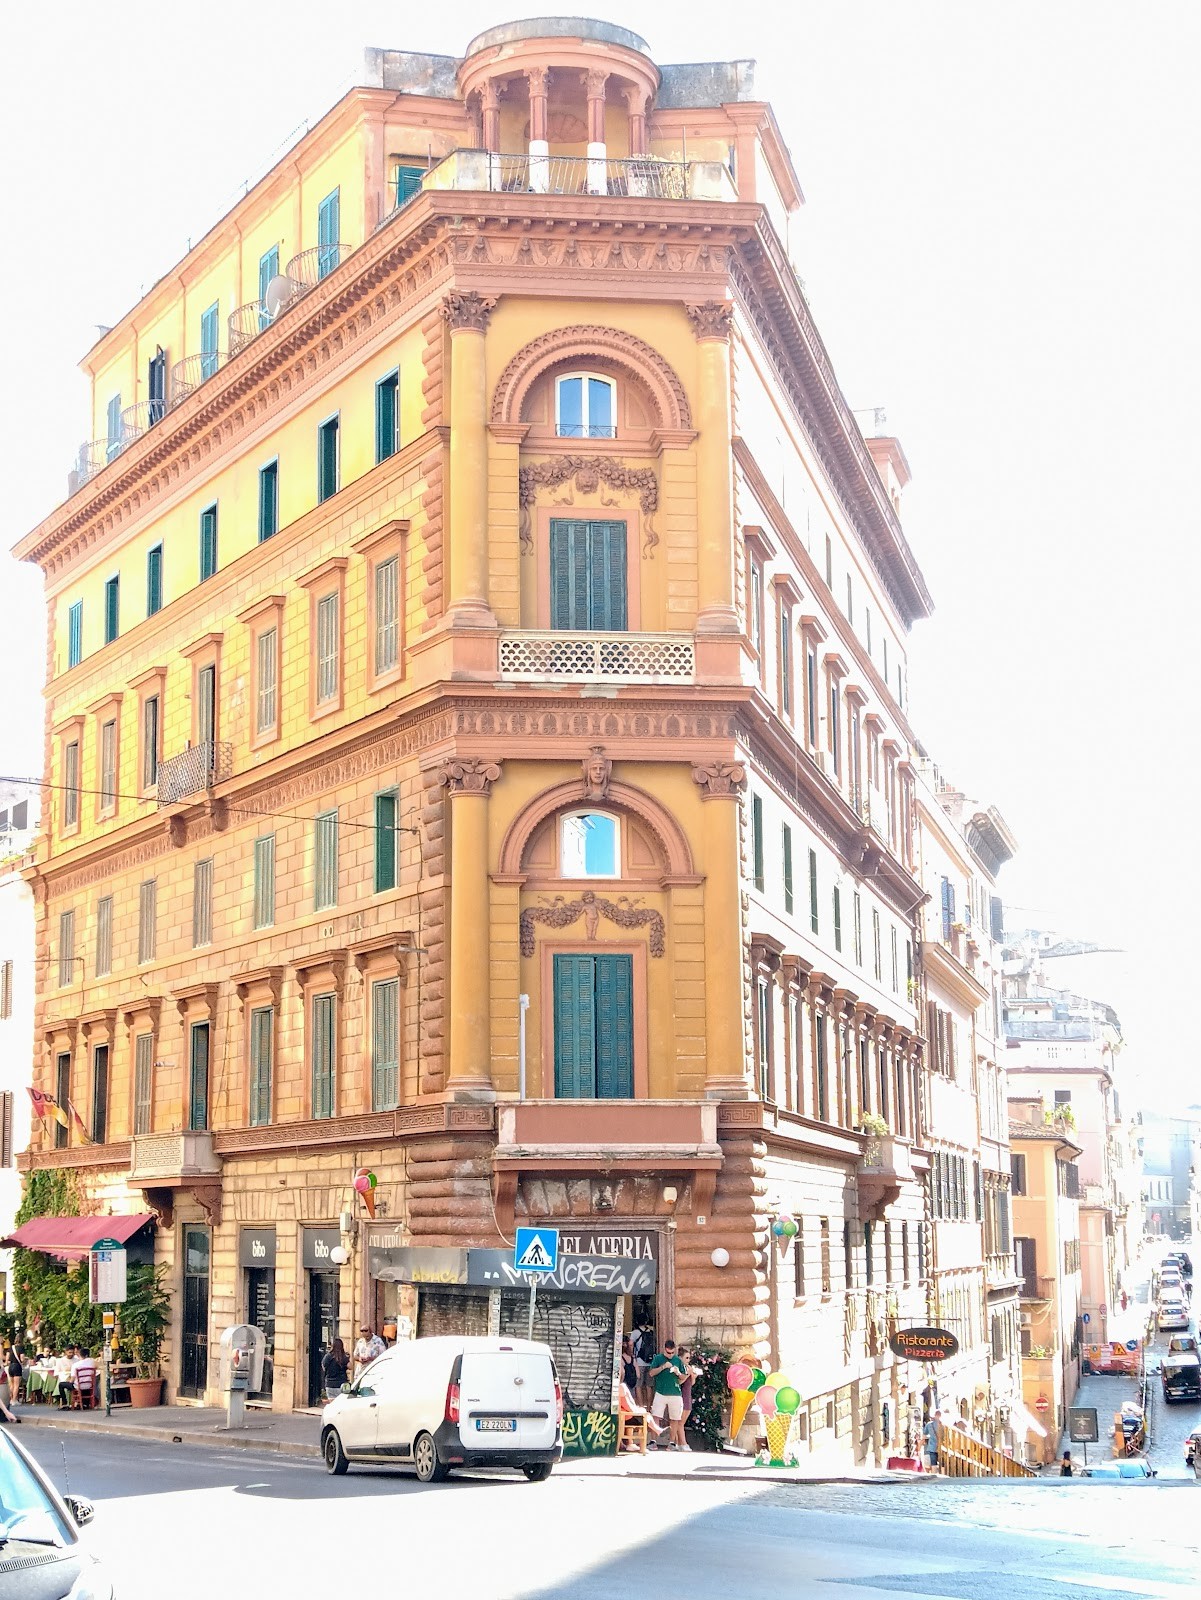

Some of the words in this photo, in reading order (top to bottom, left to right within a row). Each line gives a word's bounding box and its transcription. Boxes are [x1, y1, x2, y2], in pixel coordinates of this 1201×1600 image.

[252, 1239, 266, 1258] bibo
[314, 1239, 329, 1258] bibo
[558, 1236, 654, 1260] ELATERIA
[897, 1334, 953, 1346] Ristorante
[904, 1347, 945, 1358] Pizzeria
